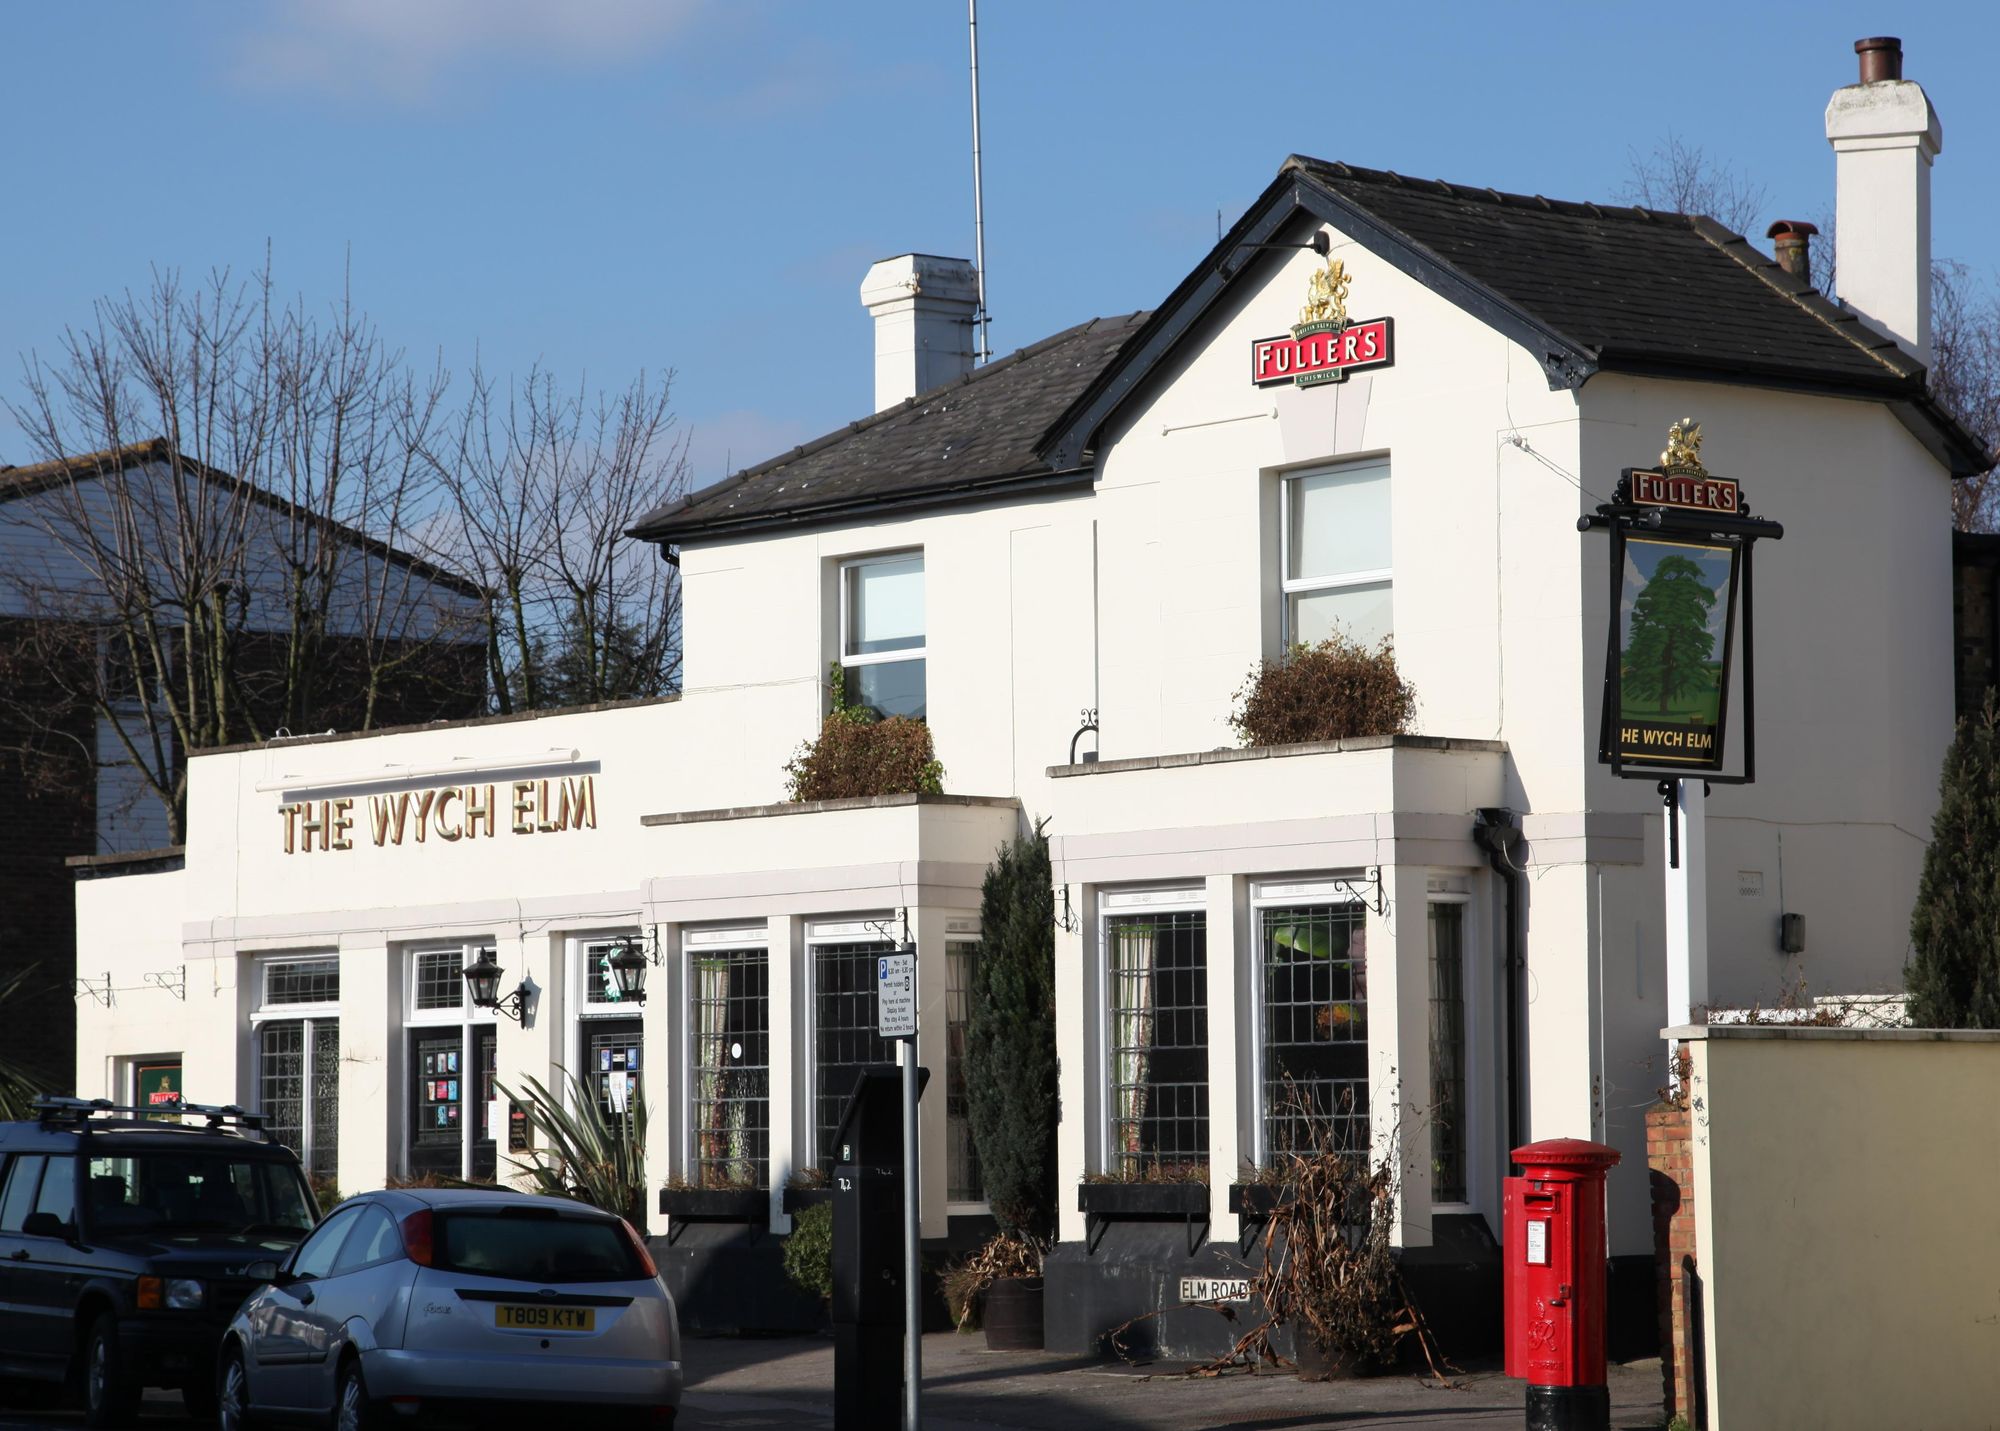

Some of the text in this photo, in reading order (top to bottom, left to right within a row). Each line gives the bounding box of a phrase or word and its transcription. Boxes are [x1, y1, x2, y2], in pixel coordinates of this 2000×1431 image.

[1259, 328, 1377, 375] FULLER'S
[1299, 371, 1336, 383] CHISWICK
[1640, 476, 1732, 508] FULLER'S
[1621, 728, 1712, 749] HE WYCH ELM
[278, 775, 597, 855] THE WYCH ELM
[1182, 1281, 1249, 1300] ELM ROAD
[504, 1306, 586, 1327] T809 KTW
